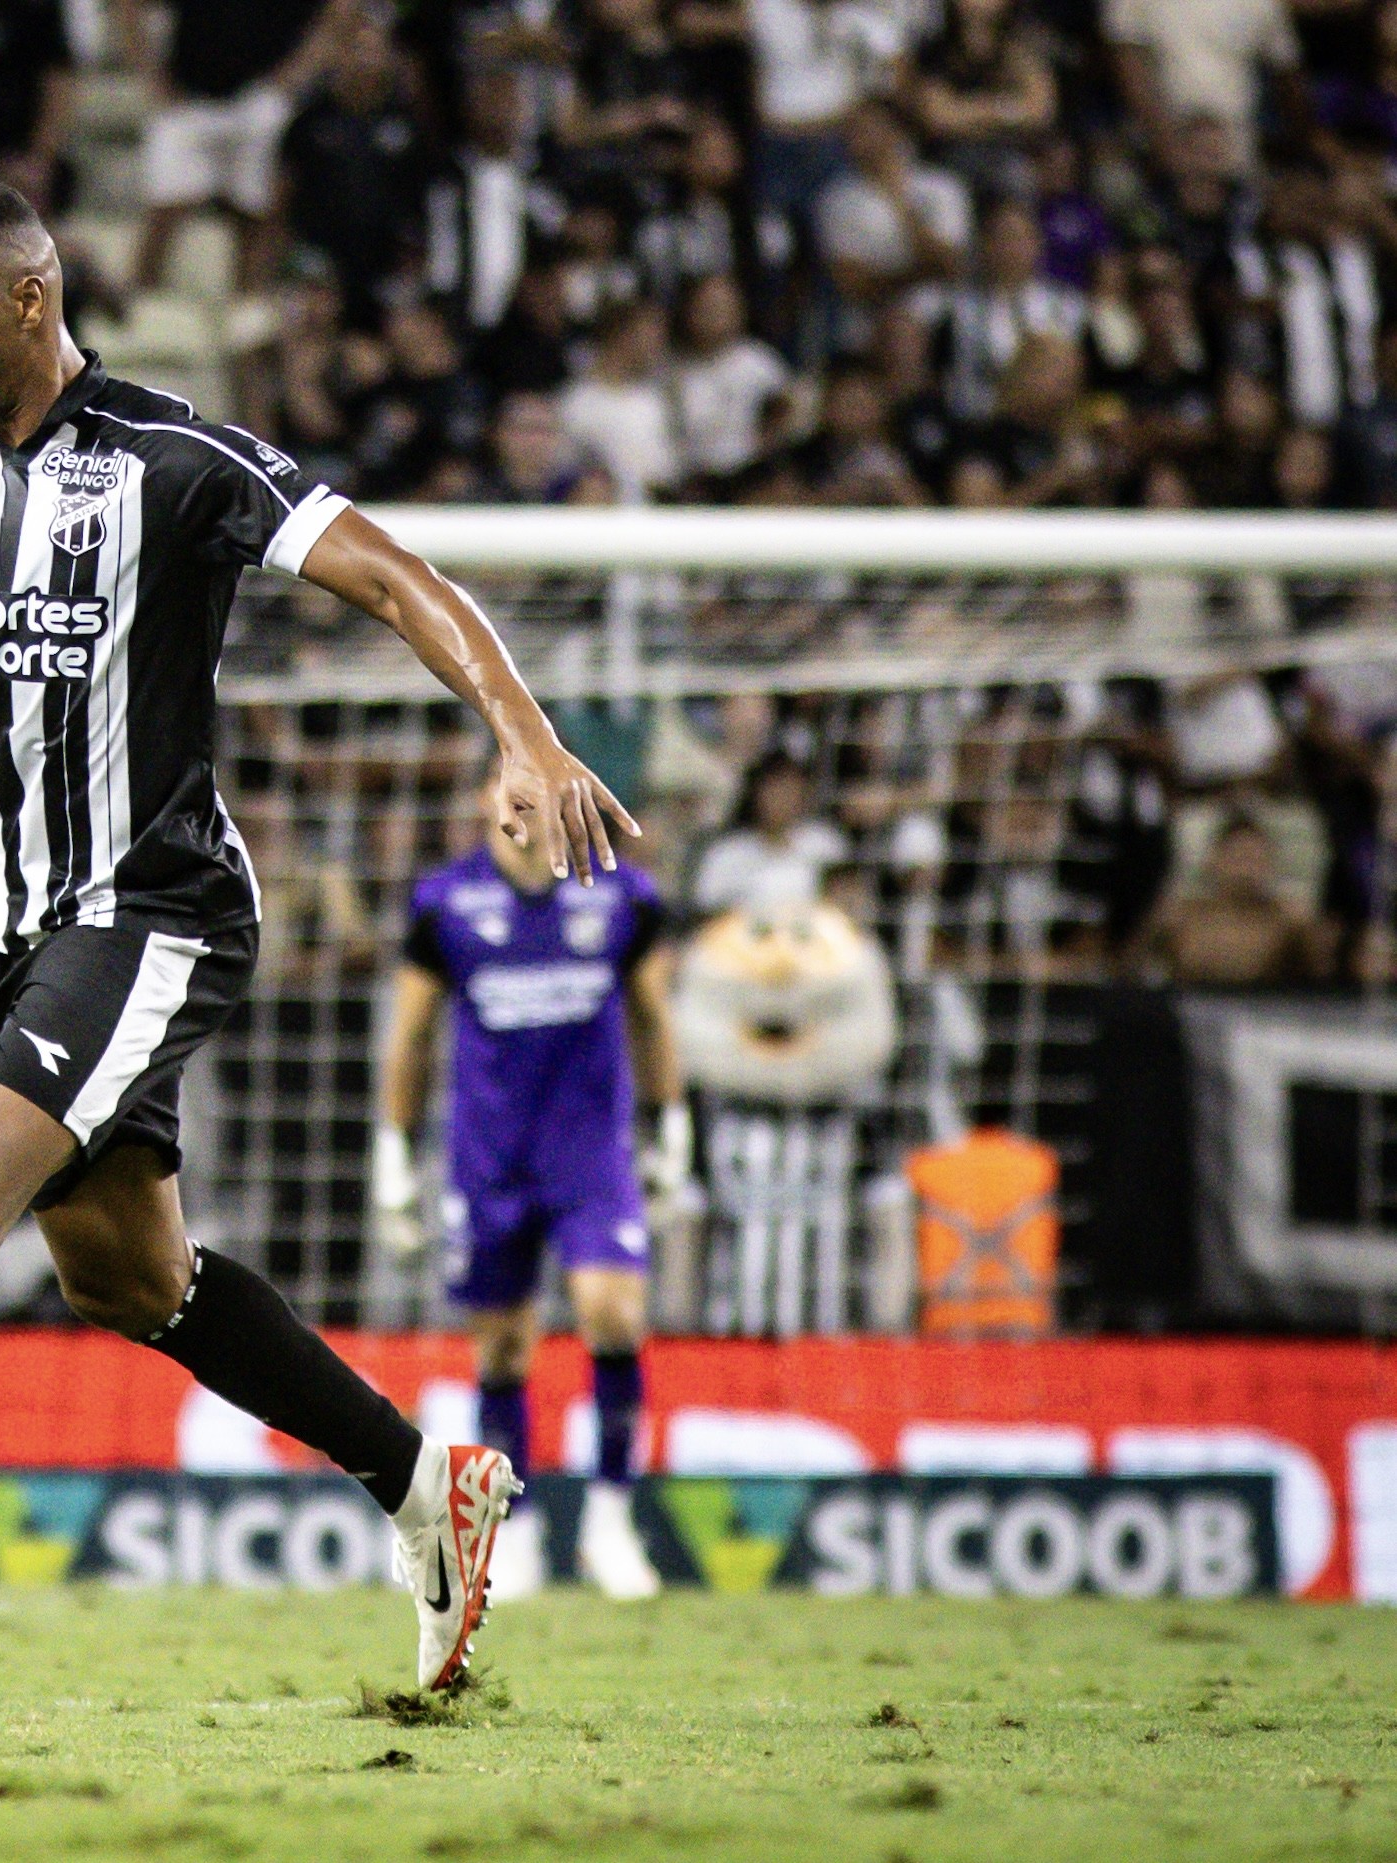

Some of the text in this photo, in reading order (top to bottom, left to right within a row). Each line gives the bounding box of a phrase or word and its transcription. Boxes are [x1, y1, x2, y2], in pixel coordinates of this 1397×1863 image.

[45, 448, 124, 475] genial
[59, 472, 116, 489] BANCO
[808, 1490, 1255, 1600] SICOOB
